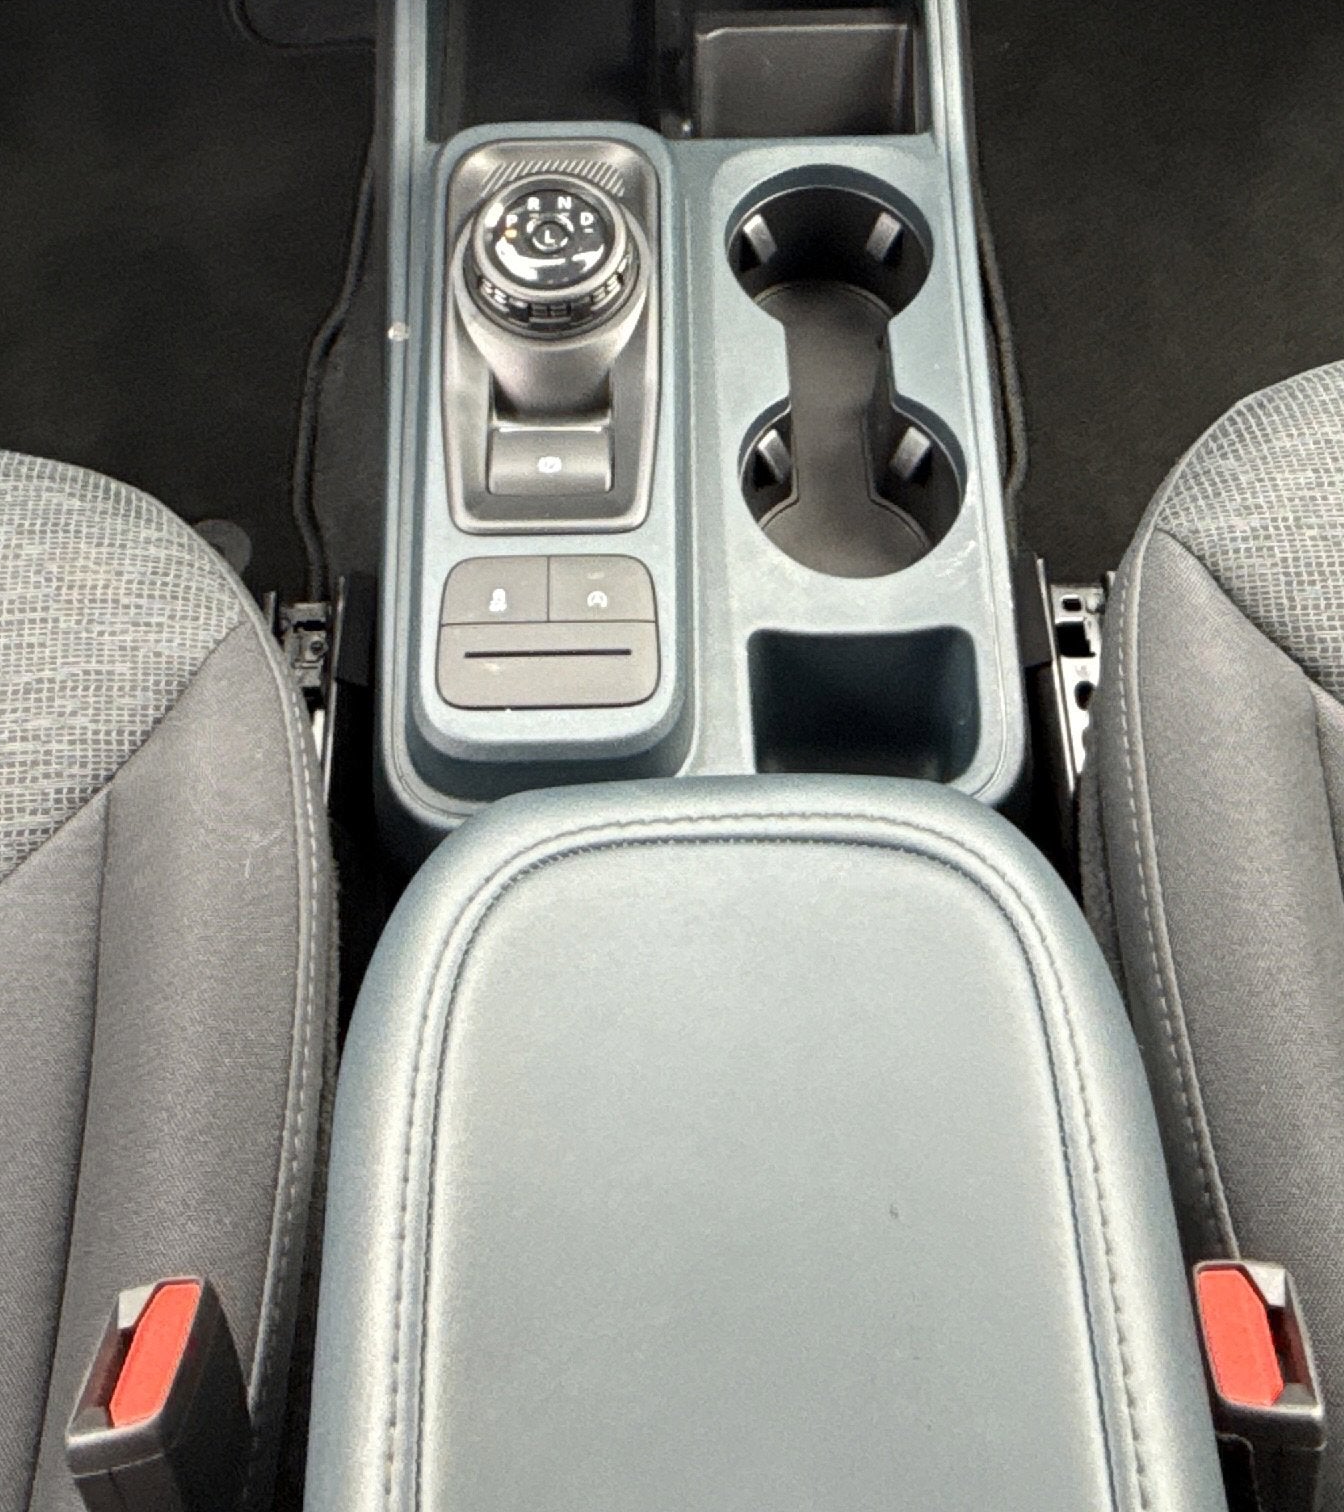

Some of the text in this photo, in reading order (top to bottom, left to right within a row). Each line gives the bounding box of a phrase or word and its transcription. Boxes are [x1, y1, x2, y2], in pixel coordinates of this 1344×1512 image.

[527, 196, 572, 211] R N
[506, 211, 594, 227] P D
[544, 229, 555, 244] L
